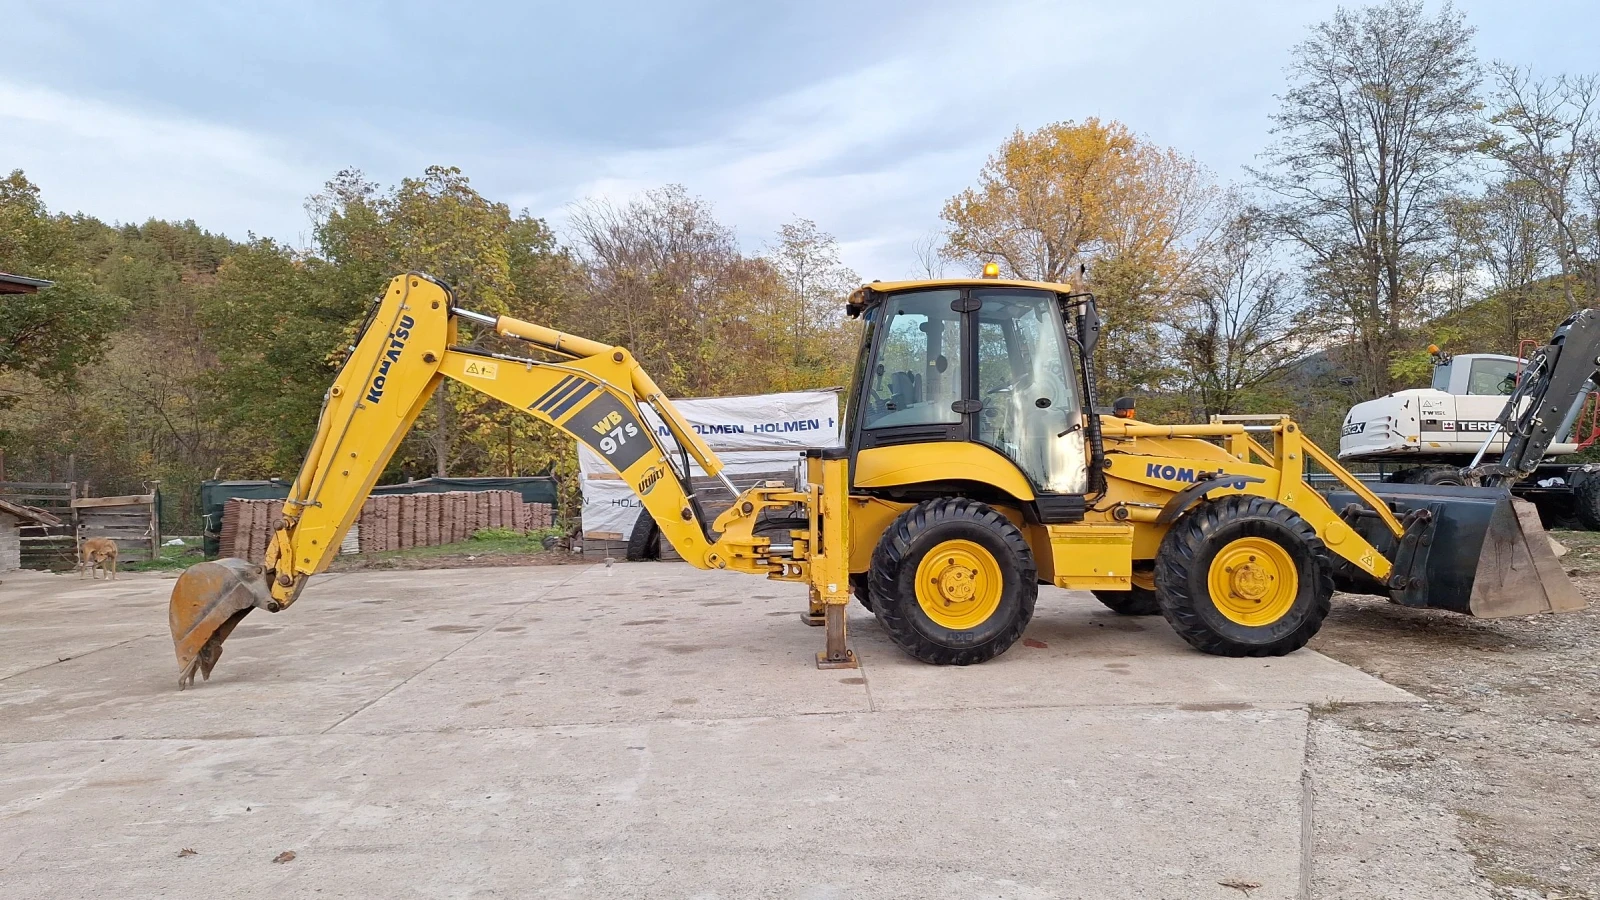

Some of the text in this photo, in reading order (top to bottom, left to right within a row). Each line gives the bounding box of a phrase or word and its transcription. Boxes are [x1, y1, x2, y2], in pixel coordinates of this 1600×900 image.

[366, 314, 415, 404] KOMATSU
[592, 410, 622, 435] WB
[692, 419, 745, 434] OLMEN
[753, 418, 820, 433] HOLMEN
[600, 422, 638, 455] 97s
[638, 466, 665, 493] Utility
